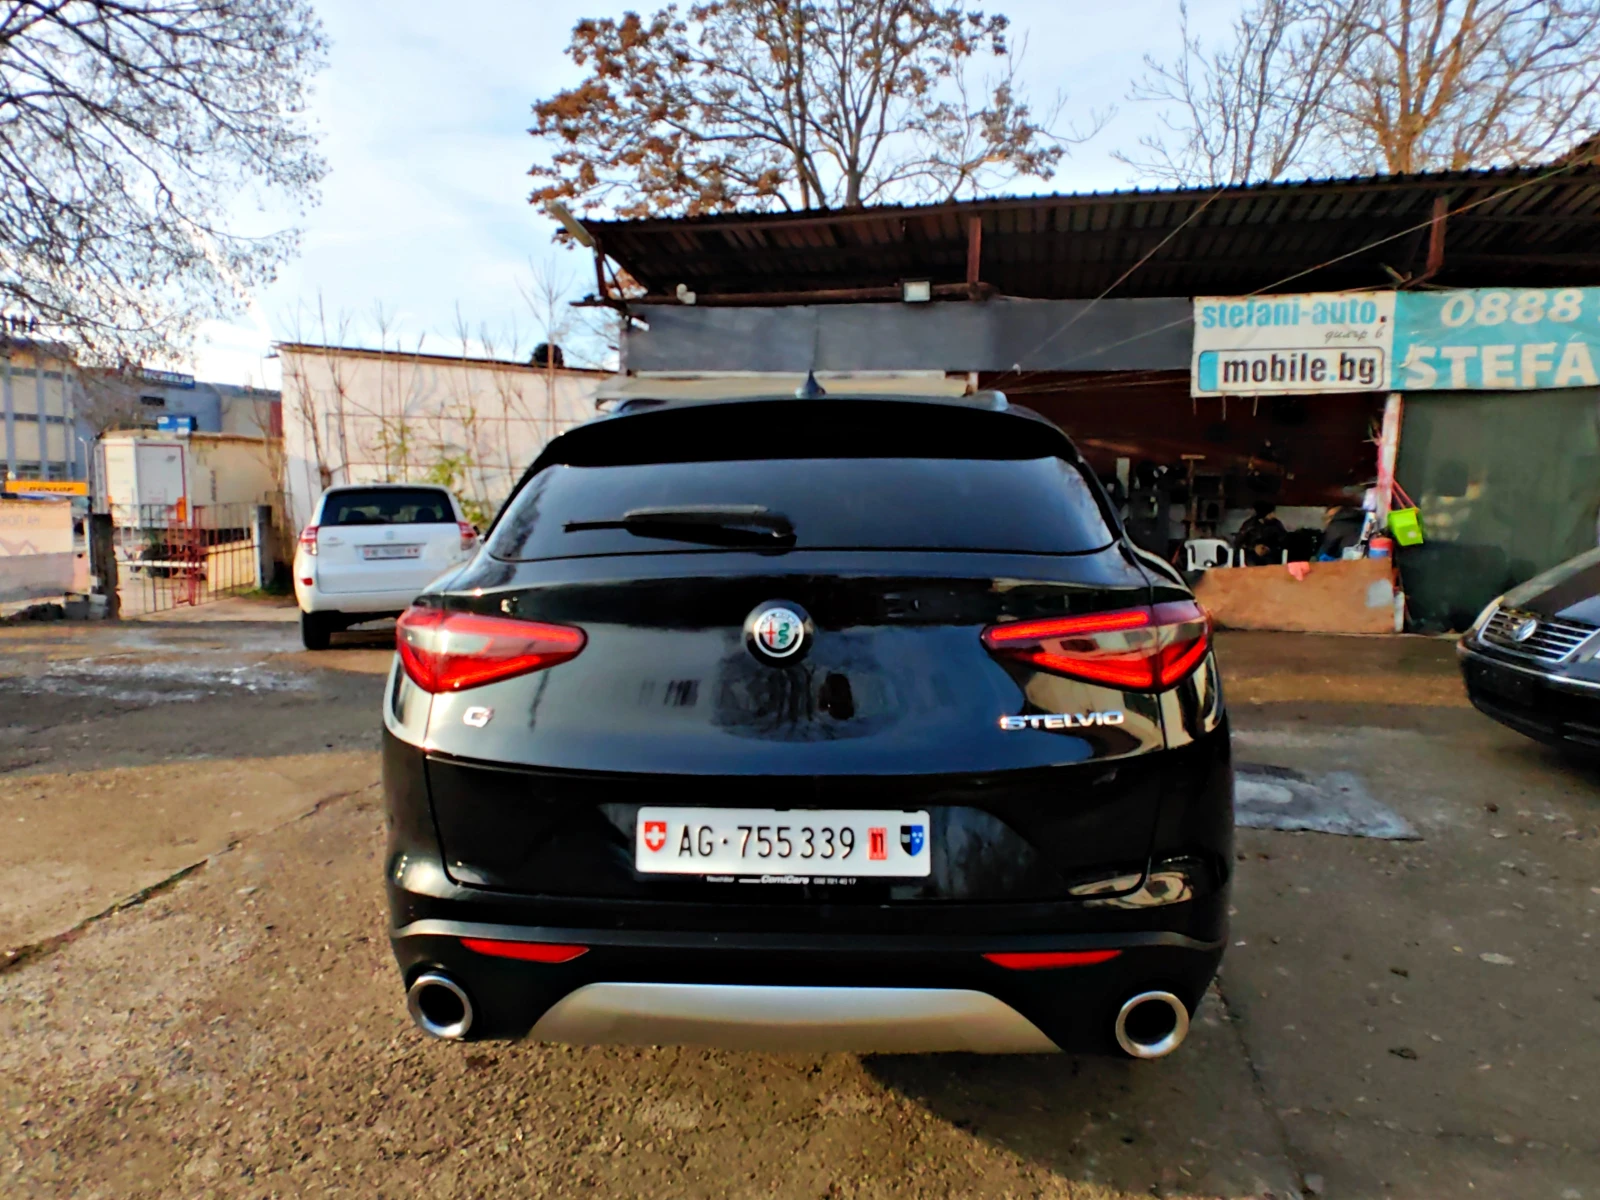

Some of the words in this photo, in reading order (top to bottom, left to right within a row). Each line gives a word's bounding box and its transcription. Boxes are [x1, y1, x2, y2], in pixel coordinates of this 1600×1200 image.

[1441, 288, 1583, 328] 0888
[1223, 351, 1376, 385] mobile.bg
[999, 710, 1125, 731] STELVIO
